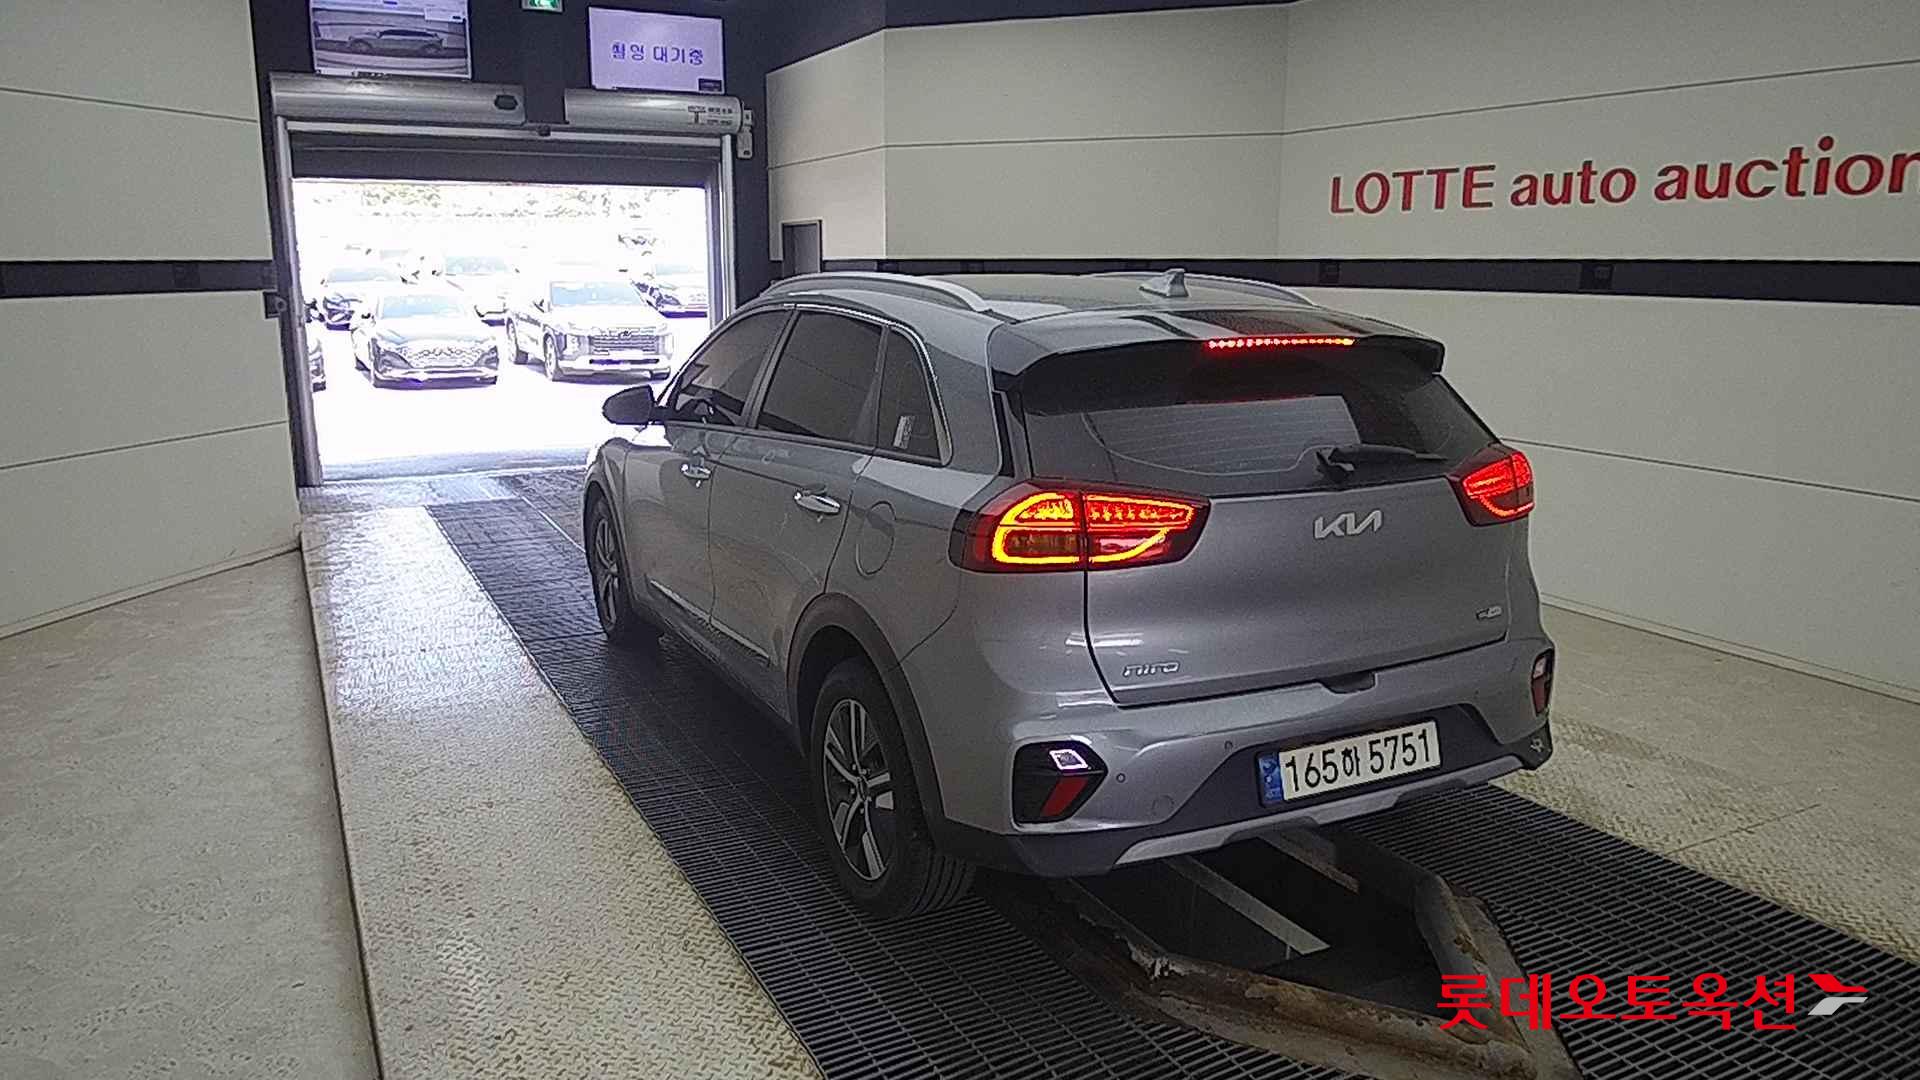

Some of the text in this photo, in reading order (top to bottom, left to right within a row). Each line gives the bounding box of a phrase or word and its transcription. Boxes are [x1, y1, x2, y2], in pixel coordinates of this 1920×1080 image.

[653, 46, 704, 66] 대기중
[1330, 164, 1497, 215] LOTTE
[1510, 160, 1638, 207] auto
[1285, 728, 1430, 792] 165하 5751
